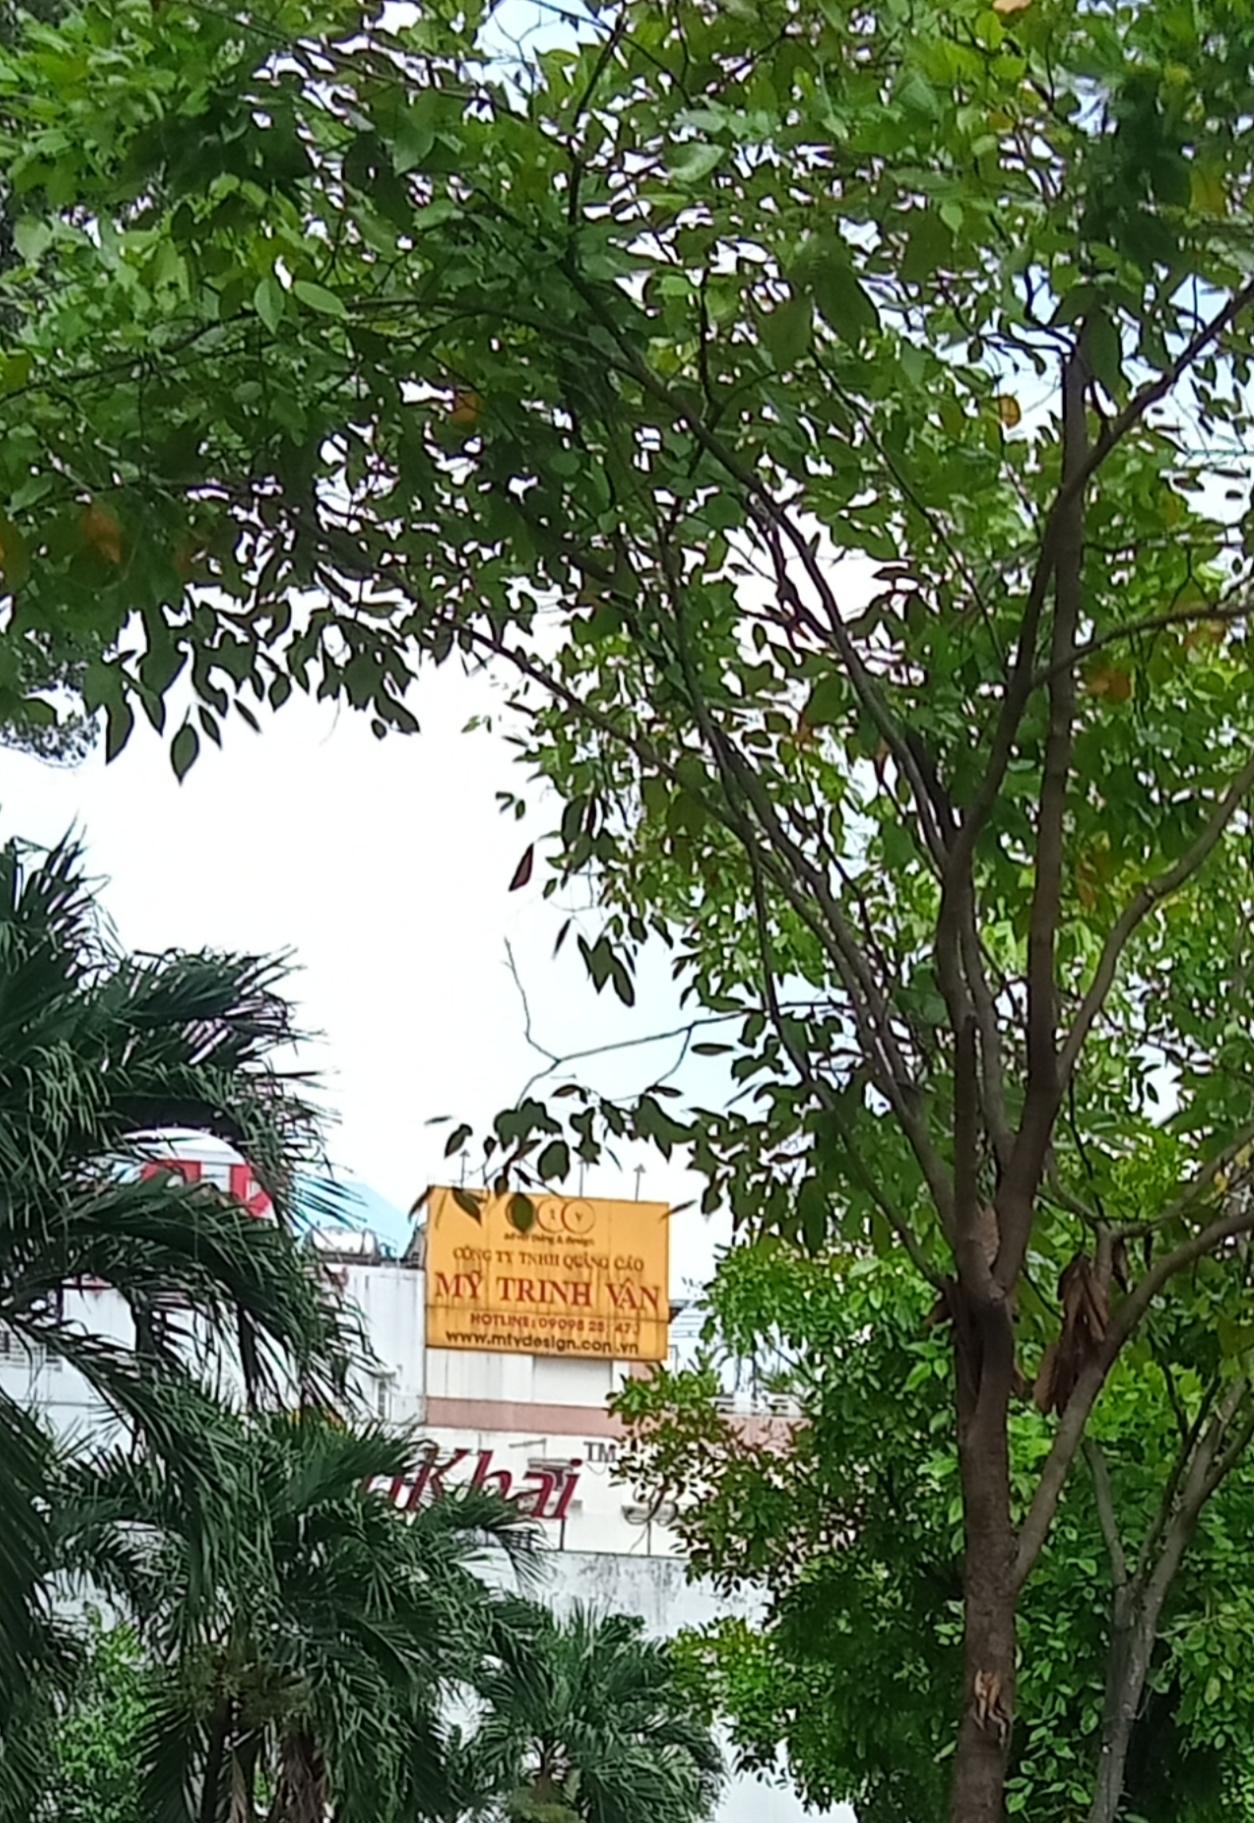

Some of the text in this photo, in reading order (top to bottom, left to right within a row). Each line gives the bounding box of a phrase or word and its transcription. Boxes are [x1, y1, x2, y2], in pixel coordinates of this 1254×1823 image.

[495, 1249, 514, 1265] TY
[519, 1251, 560, 1267] TNHH
[614, 1254, 645, 1272] CÁO
[496, 1275, 593, 1307] TRINH
[605, 1277, 661, 1312] VÂN
